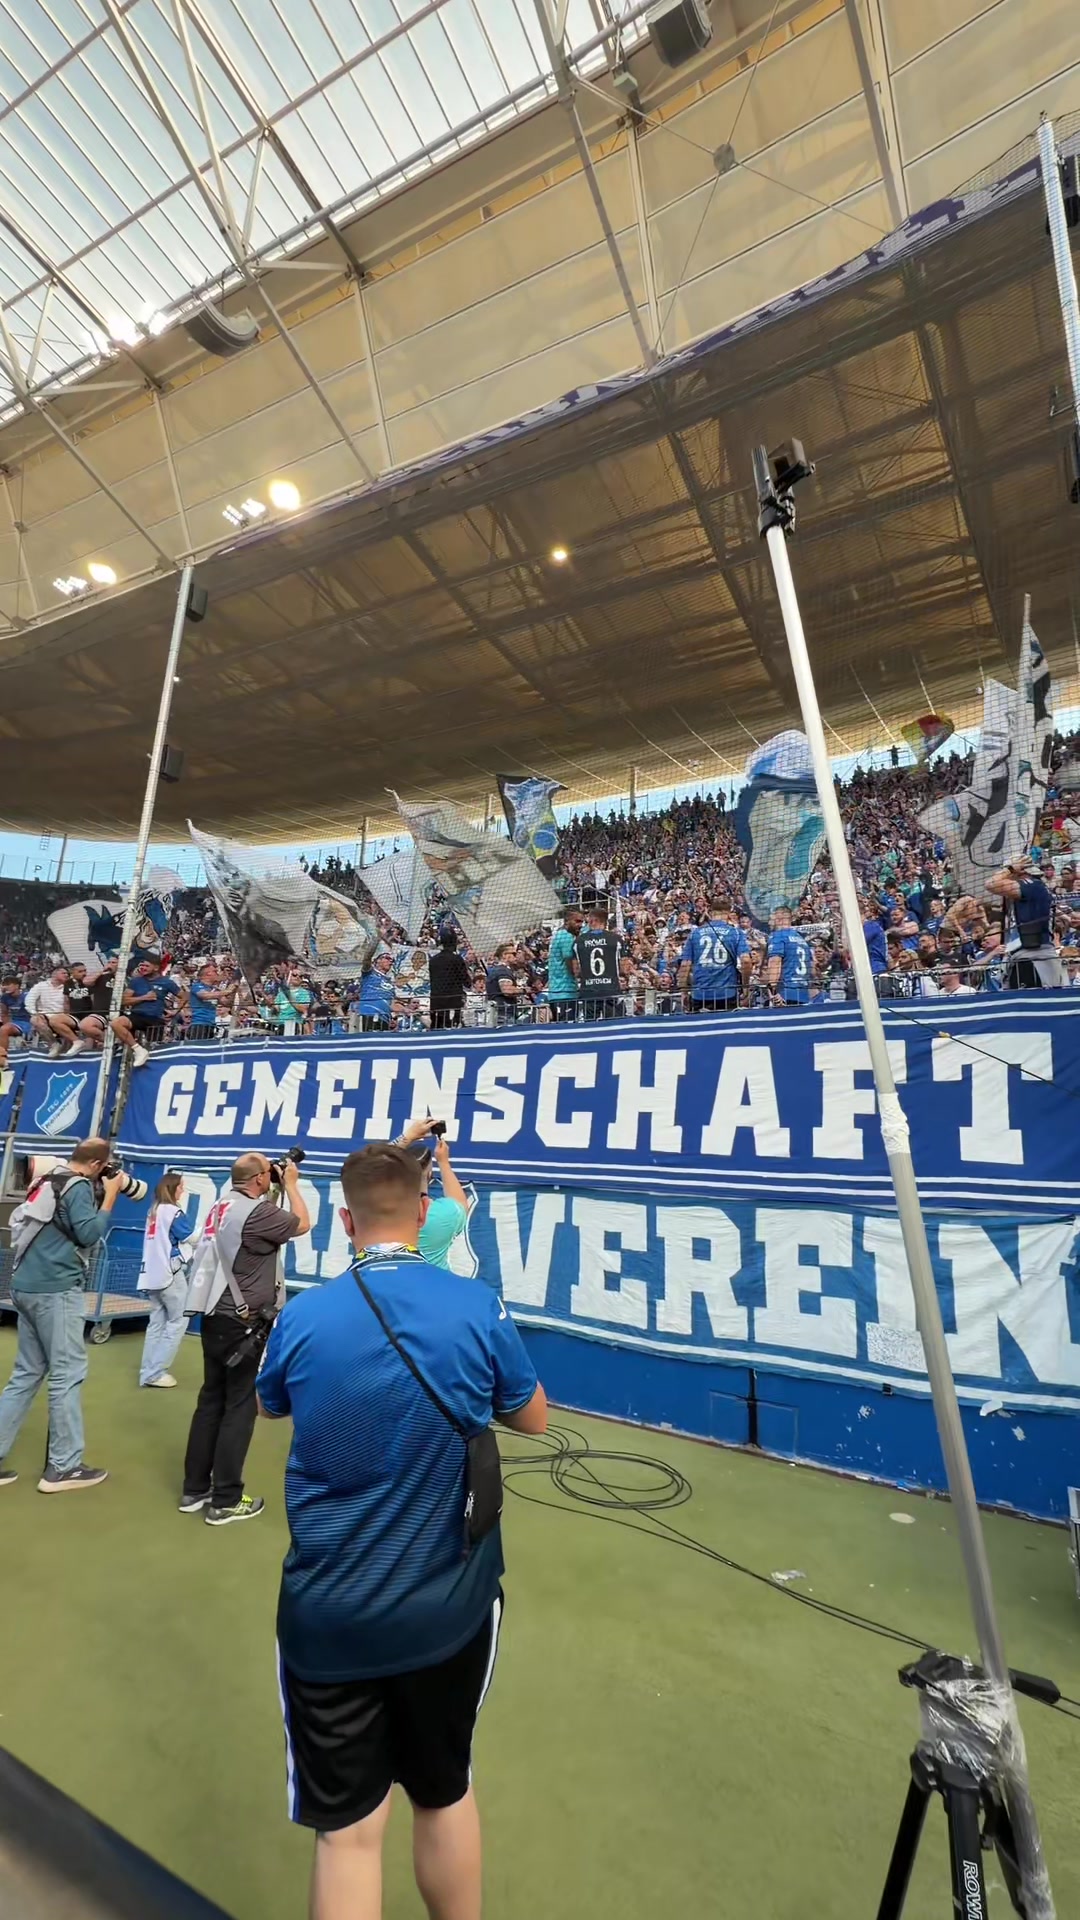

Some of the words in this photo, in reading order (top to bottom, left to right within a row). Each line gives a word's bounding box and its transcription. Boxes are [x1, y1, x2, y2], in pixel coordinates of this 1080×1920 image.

[589, 947, 606, 977] 6
[698, 935, 728, 964] 26
[795, 946, 807, 976] 3
[154, 1032, 1054, 1165] GEMEINSCHAFT
[489, 1190, 1080, 1387] VEREIN
